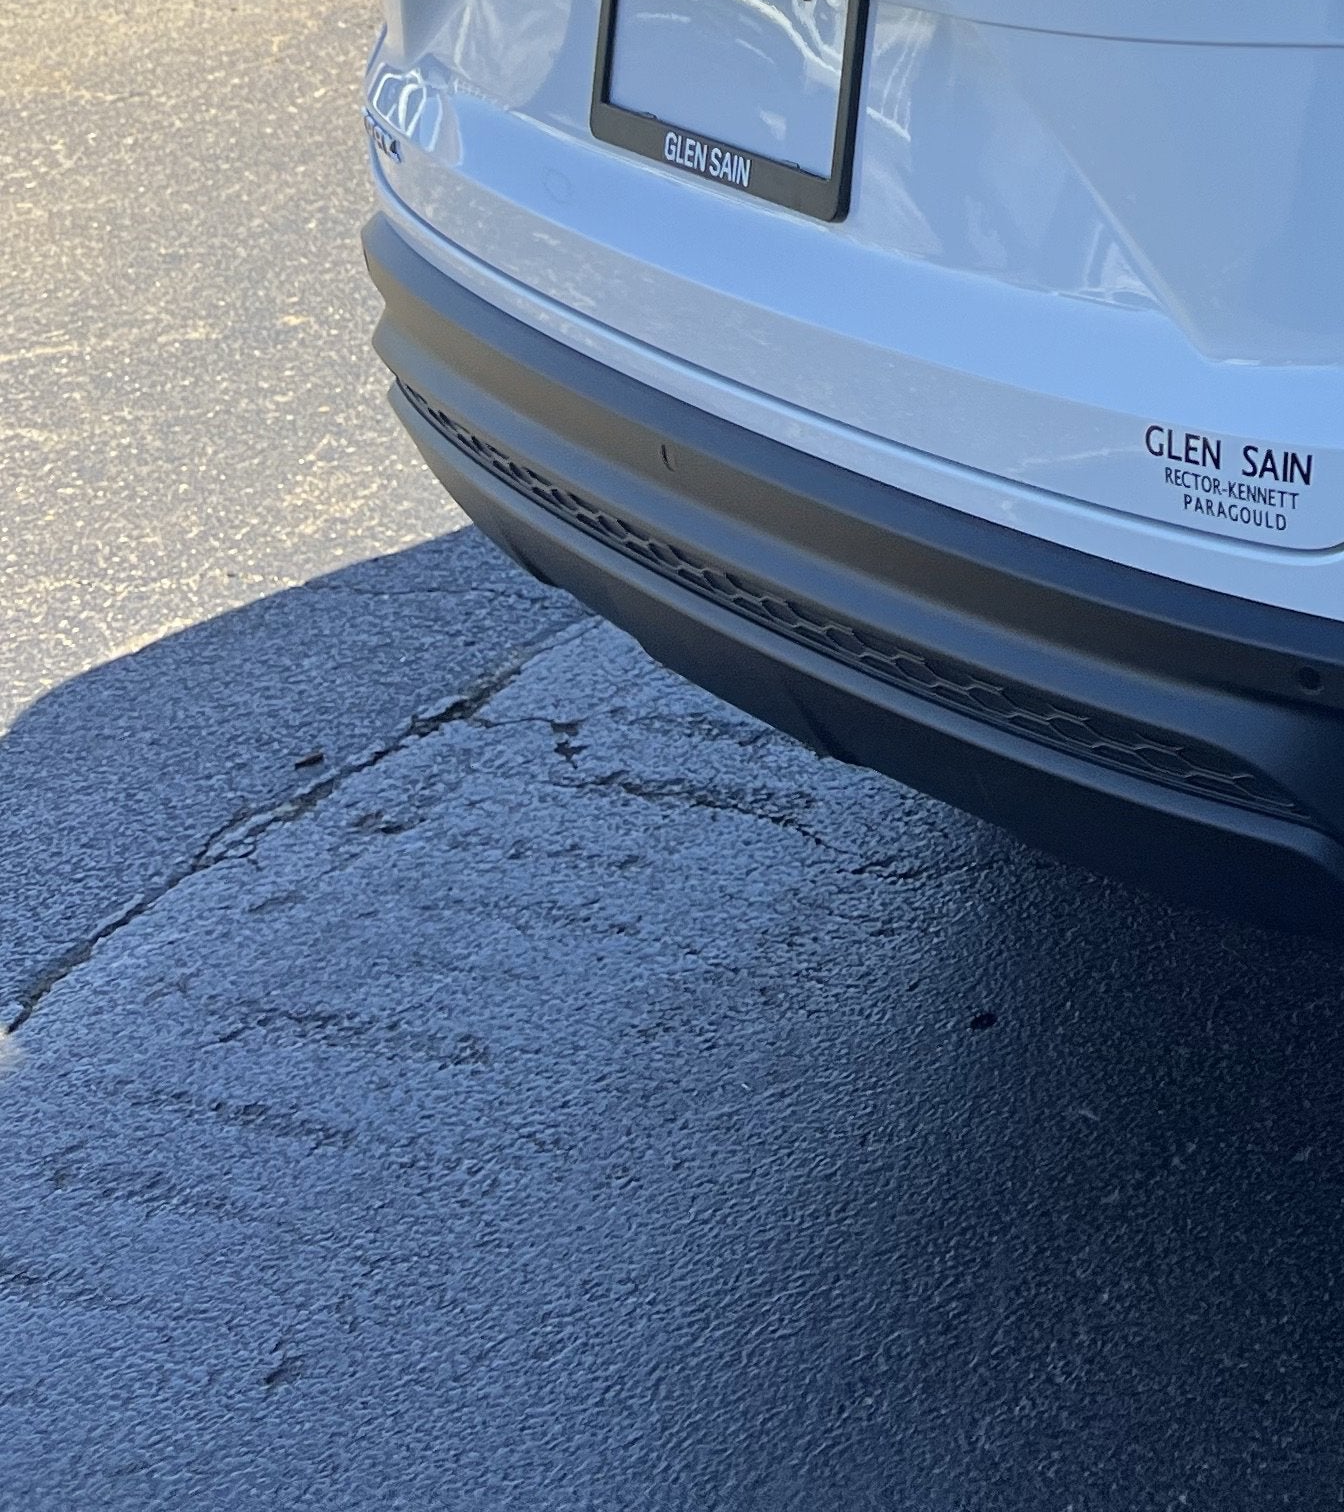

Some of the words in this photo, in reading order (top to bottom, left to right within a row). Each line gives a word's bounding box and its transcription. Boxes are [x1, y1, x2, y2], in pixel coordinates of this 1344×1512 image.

[664, 131, 708, 173] GLEN
[709, 147, 751, 187] SAIN
[1145, 425, 1221, 470] GLEN
[1242, 445, 1313, 486] SAIN
[1165, 467, 1300, 510] RECTOR-KENNETT
[1183, 494, 1287, 531] PARAGOULD
